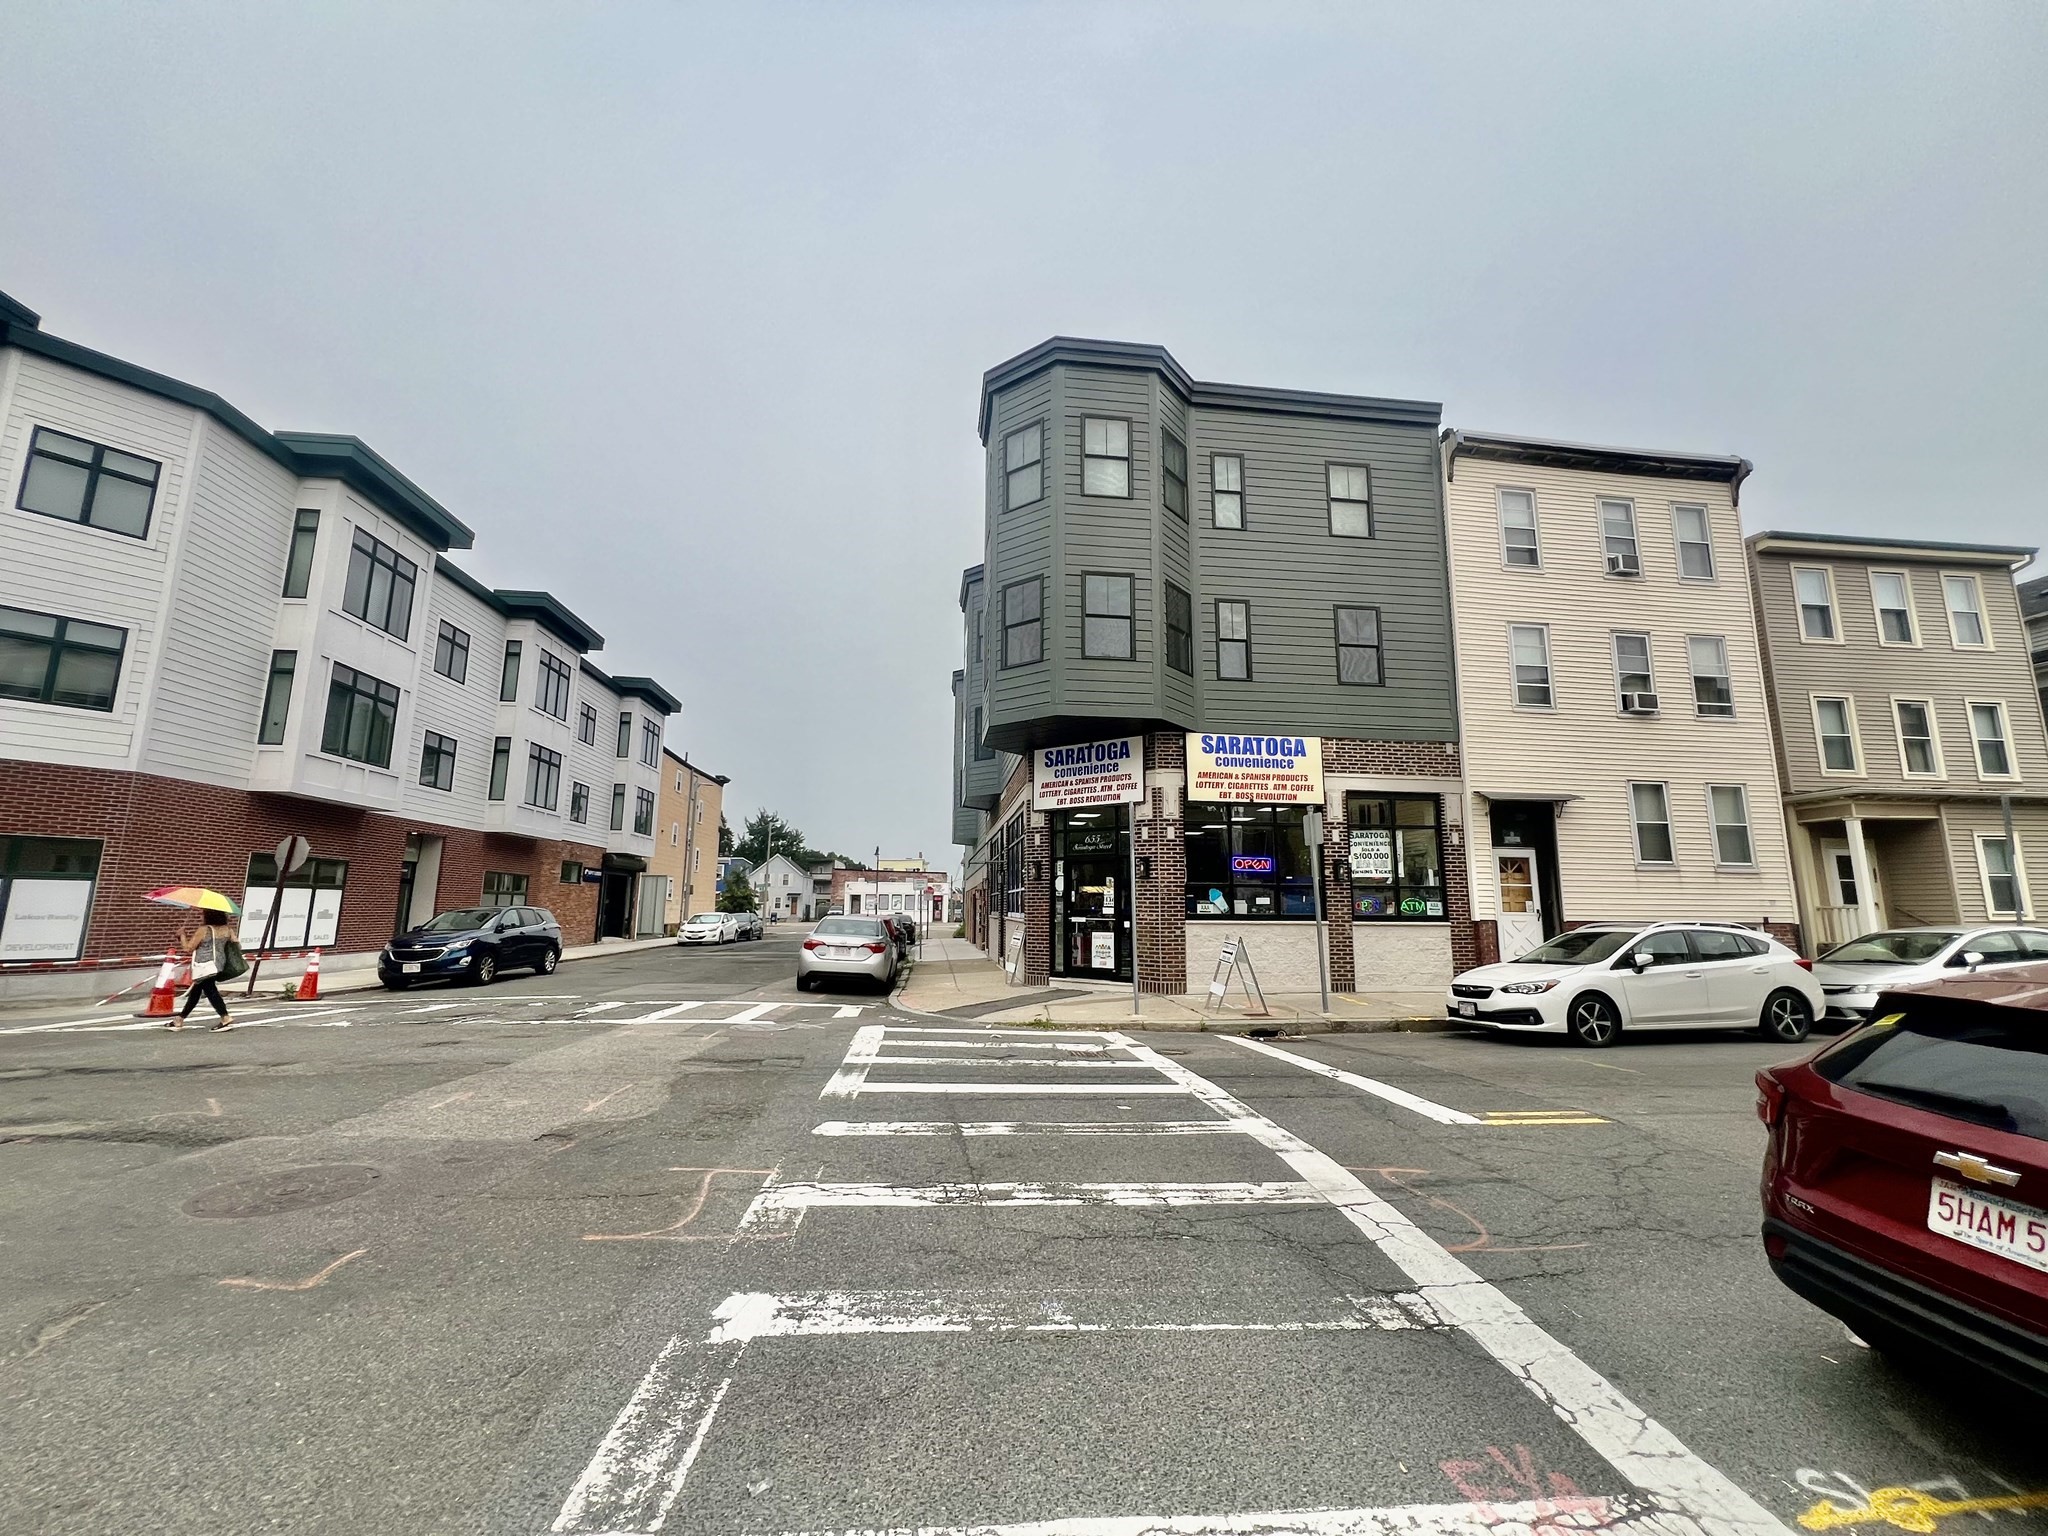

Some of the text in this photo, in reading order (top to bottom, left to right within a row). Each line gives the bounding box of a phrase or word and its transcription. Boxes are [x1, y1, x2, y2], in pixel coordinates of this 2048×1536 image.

[1201, 734, 1307, 757] SARATOGA
[1044, 741, 1130, 768] SARATOGA
[1215, 757, 1294, 769] convenience
[1054, 762, 1119, 778] convenience
[1041, 781, 1069, 789] AMERICAN
[1074, 776, 1100, 786] SPANISH
[1100, 773, 1132, 782] PRODUCTS
[1197, 772, 1234, 780] AMERICAN
[1240, 773, 1271, 781] SPANISH
[1116, 782, 1138, 791] COFFEE
[1290, 784, 1314, 792] COFFEE
[1069, 796, 1085, 805] BOSS
[1085, 793, 1121, 803] REVOLUTION
[1235, 792, 1254, 800] BOSS
[1255, 793, 1298, 801] REVOLUTION
[1084, 834, 1101, 844] 655
[1350, 831, 1391, 839] SARATOGA
[1234, 858, 1270, 869] OPEN
[1355, 899, 1380, 912] OPEN
[1400, 901, 1426, 911] ATM
[5, 943, 75, 952] DEVELOPMENT
[1785, 1193, 1815, 1214] TRAX
[1937, 1192, 2016, 1244] 5HAM
